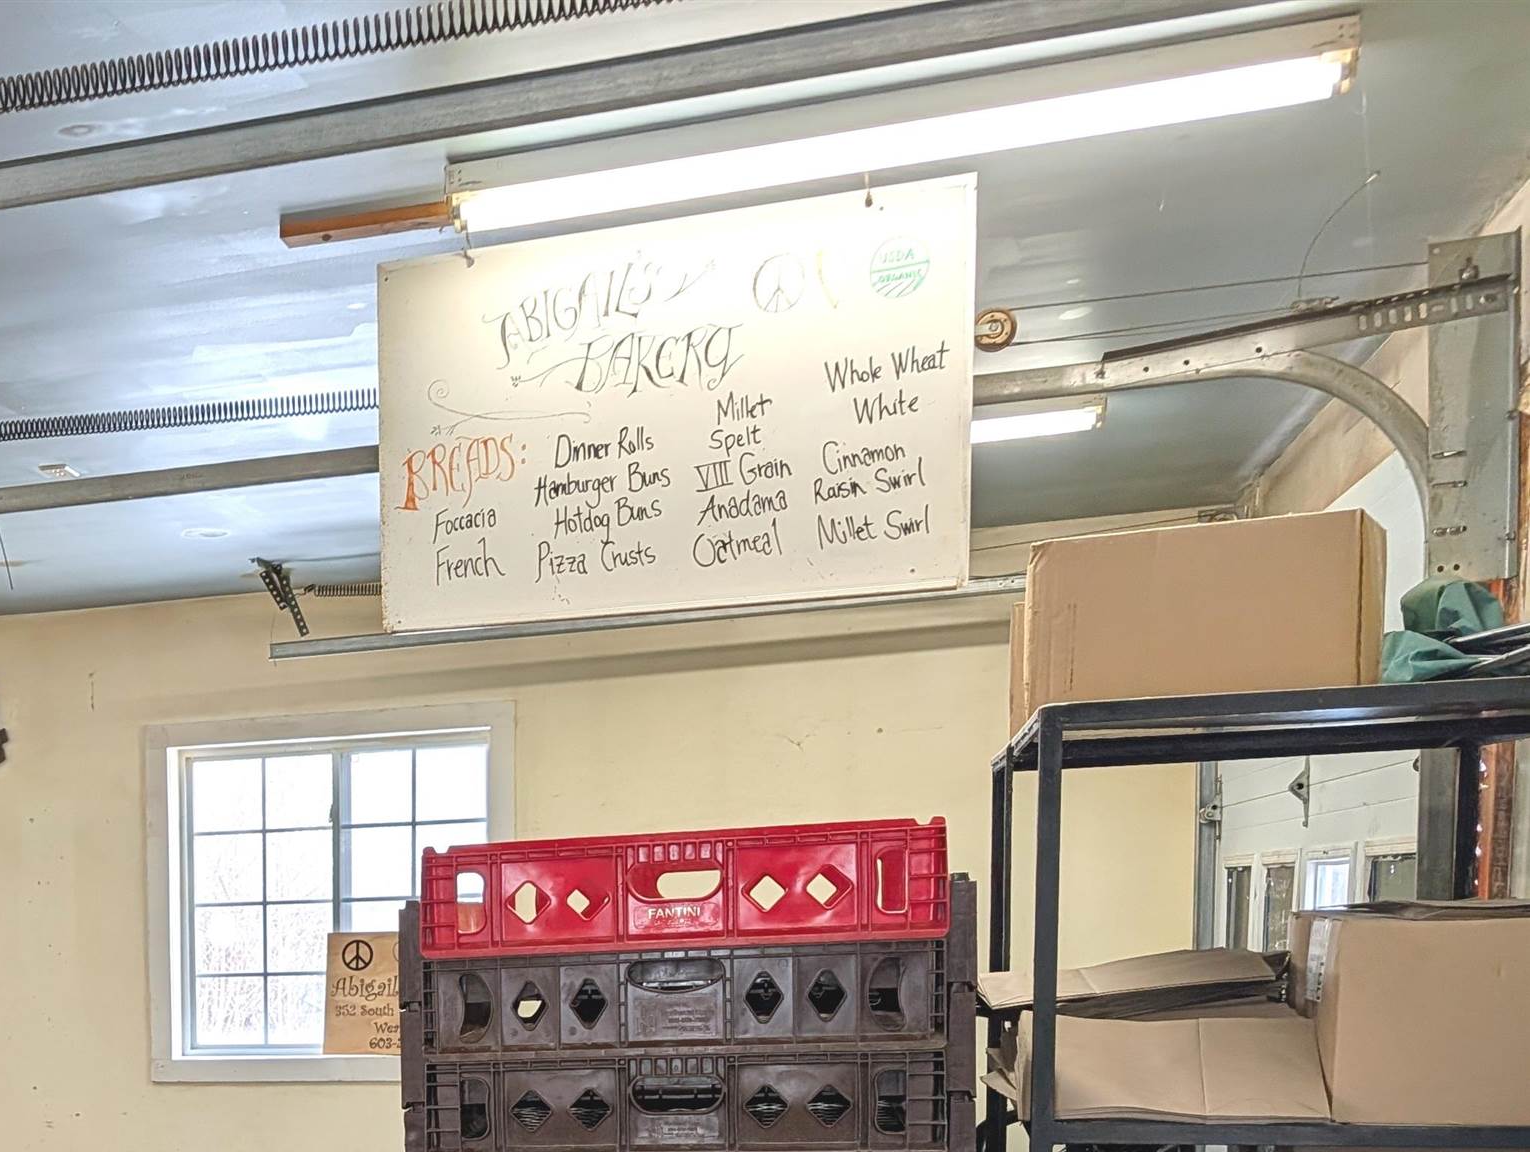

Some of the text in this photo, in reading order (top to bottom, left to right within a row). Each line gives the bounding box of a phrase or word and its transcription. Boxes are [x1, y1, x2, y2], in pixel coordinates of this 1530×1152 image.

[570, 325, 743, 397] BAKERY
[824, 340, 950, 392] Whole Wheat
[717, 391, 772, 425] Millet
[854, 389, 919, 424] White
[555, 426, 654, 468] Dinner Rolls
[709, 425, 761, 457] Spelt
[823, 441, 905, 475] Cinnamon
[535, 461, 670, 508] Hamburger Buns
[694, 452, 792, 492] VIII Grain
[813, 457, 926, 504] Raisin Swirl
[433, 508, 497, 544] Foccacia
[554, 497, 662, 541] Hotdog Buns
[697, 490, 788, 526] Anadama
[818, 504, 930, 550] Millet Swirl
[436, 537, 506, 585] French
[535, 540, 656, 583] Pizza Crusts
[693, 518, 782, 567] Oatmeal
[648, 906, 701, 919] FANTINI
[331, 975, 399, 1001] Abigail
[335, 1003, 394, 1017] 352 South
[374, 1021, 400, 1034] Wea
